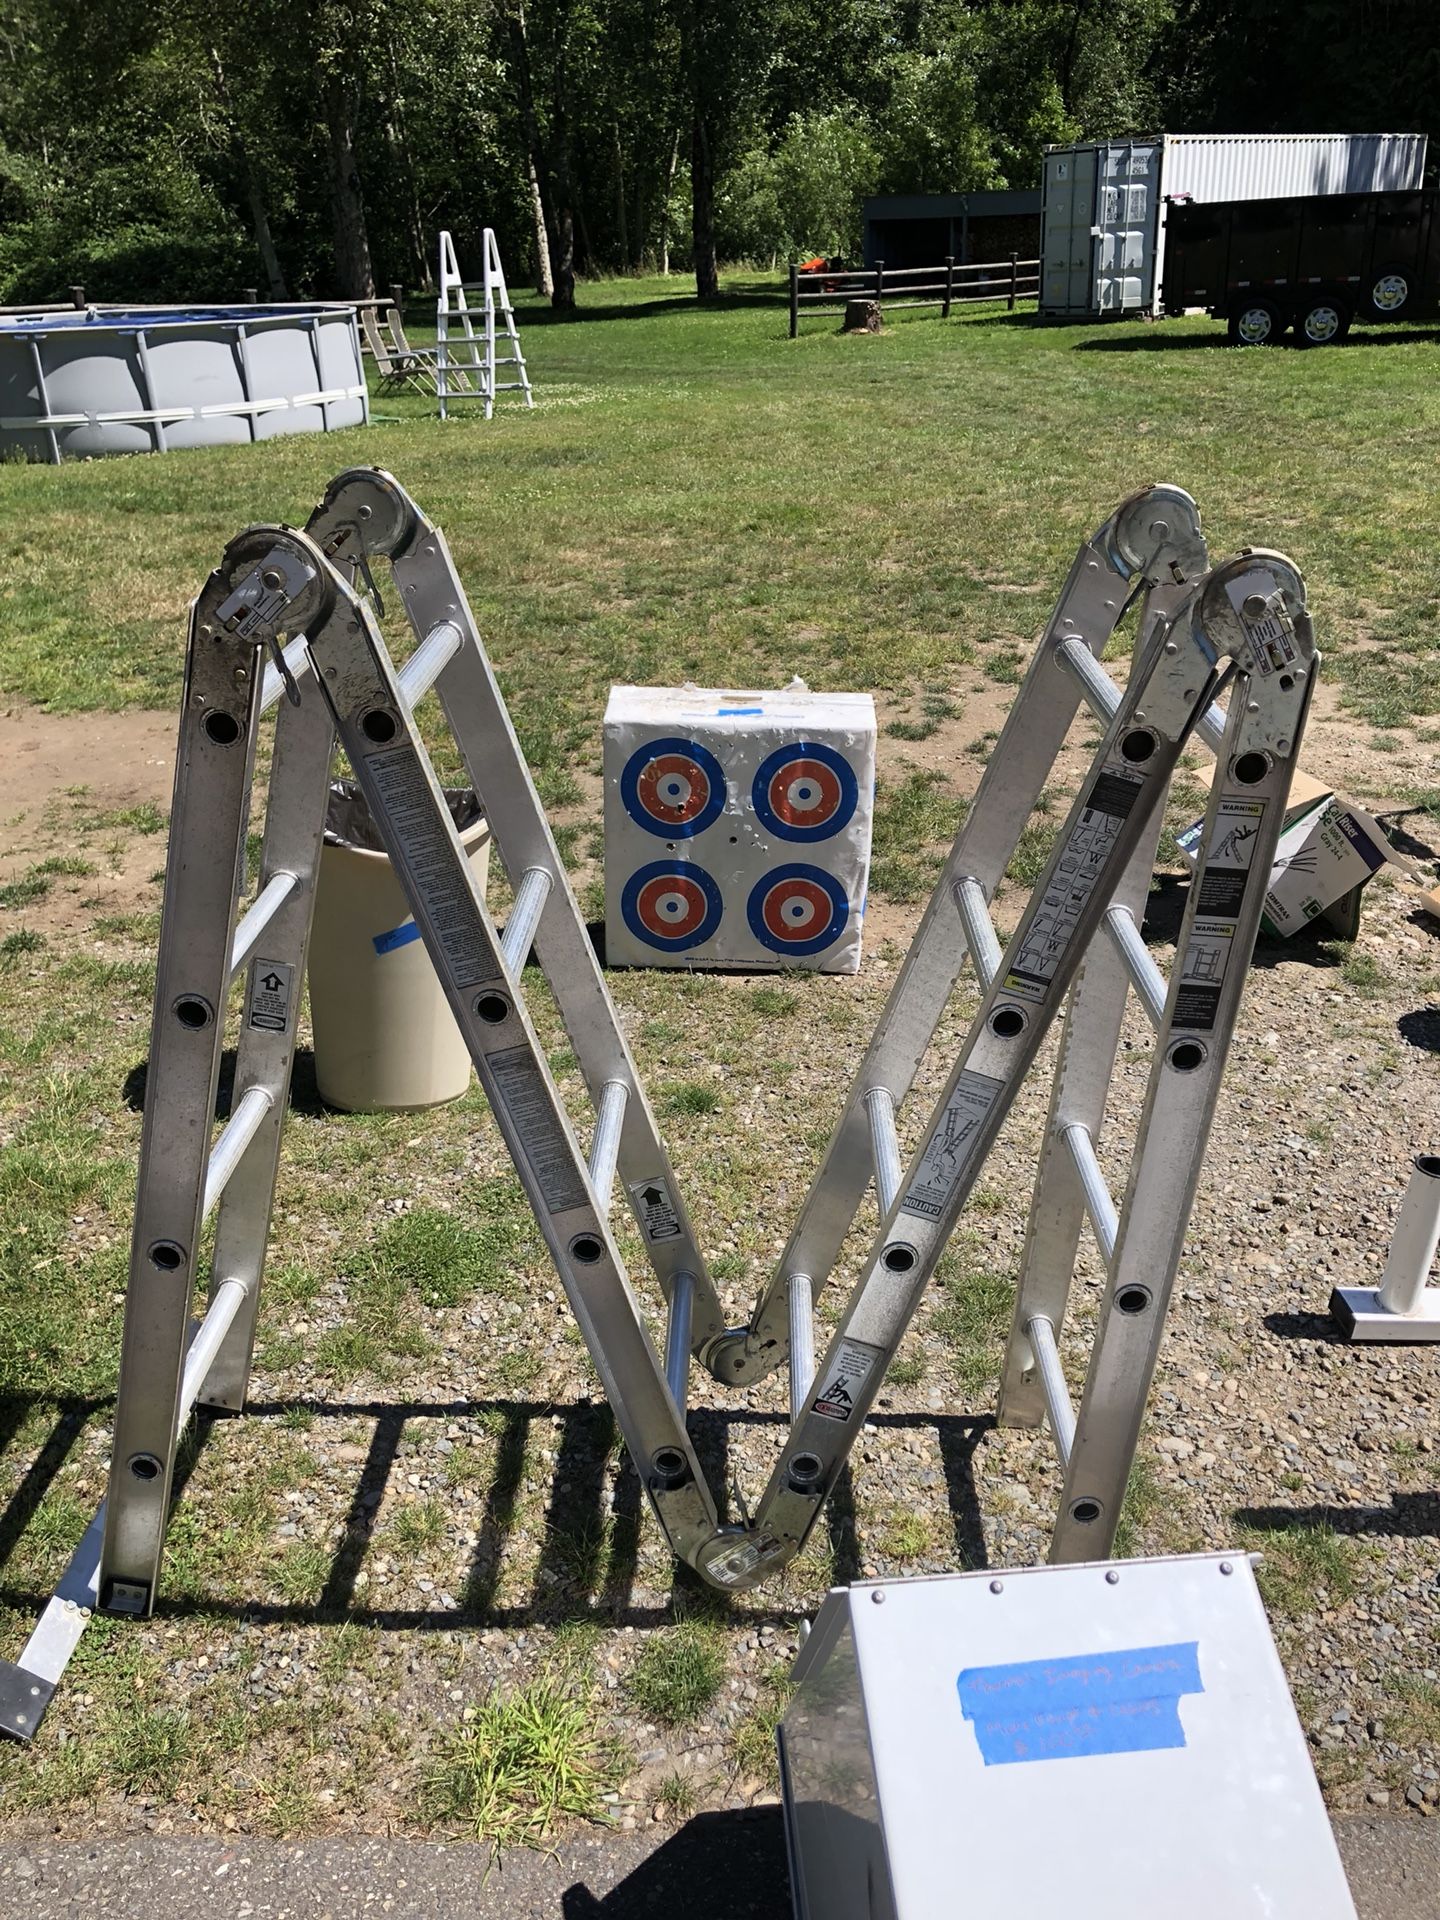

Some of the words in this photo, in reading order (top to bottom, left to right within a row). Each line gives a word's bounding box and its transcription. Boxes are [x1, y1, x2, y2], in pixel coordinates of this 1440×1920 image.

[1222, 804, 1259, 812] WARNING
[1328, 804, 1343, 820] Cat
[1318, 811, 1332, 827] 5e
[1339, 816, 1359, 838] Riser
[1320, 832, 1332, 848] Gray
[1328, 826, 1342, 841] 1000
[1195, 925, 1231, 933] WARNING
[1011, 980, 1041, 992] WARNING
[903, 1197, 941, 1215] CAUTION
